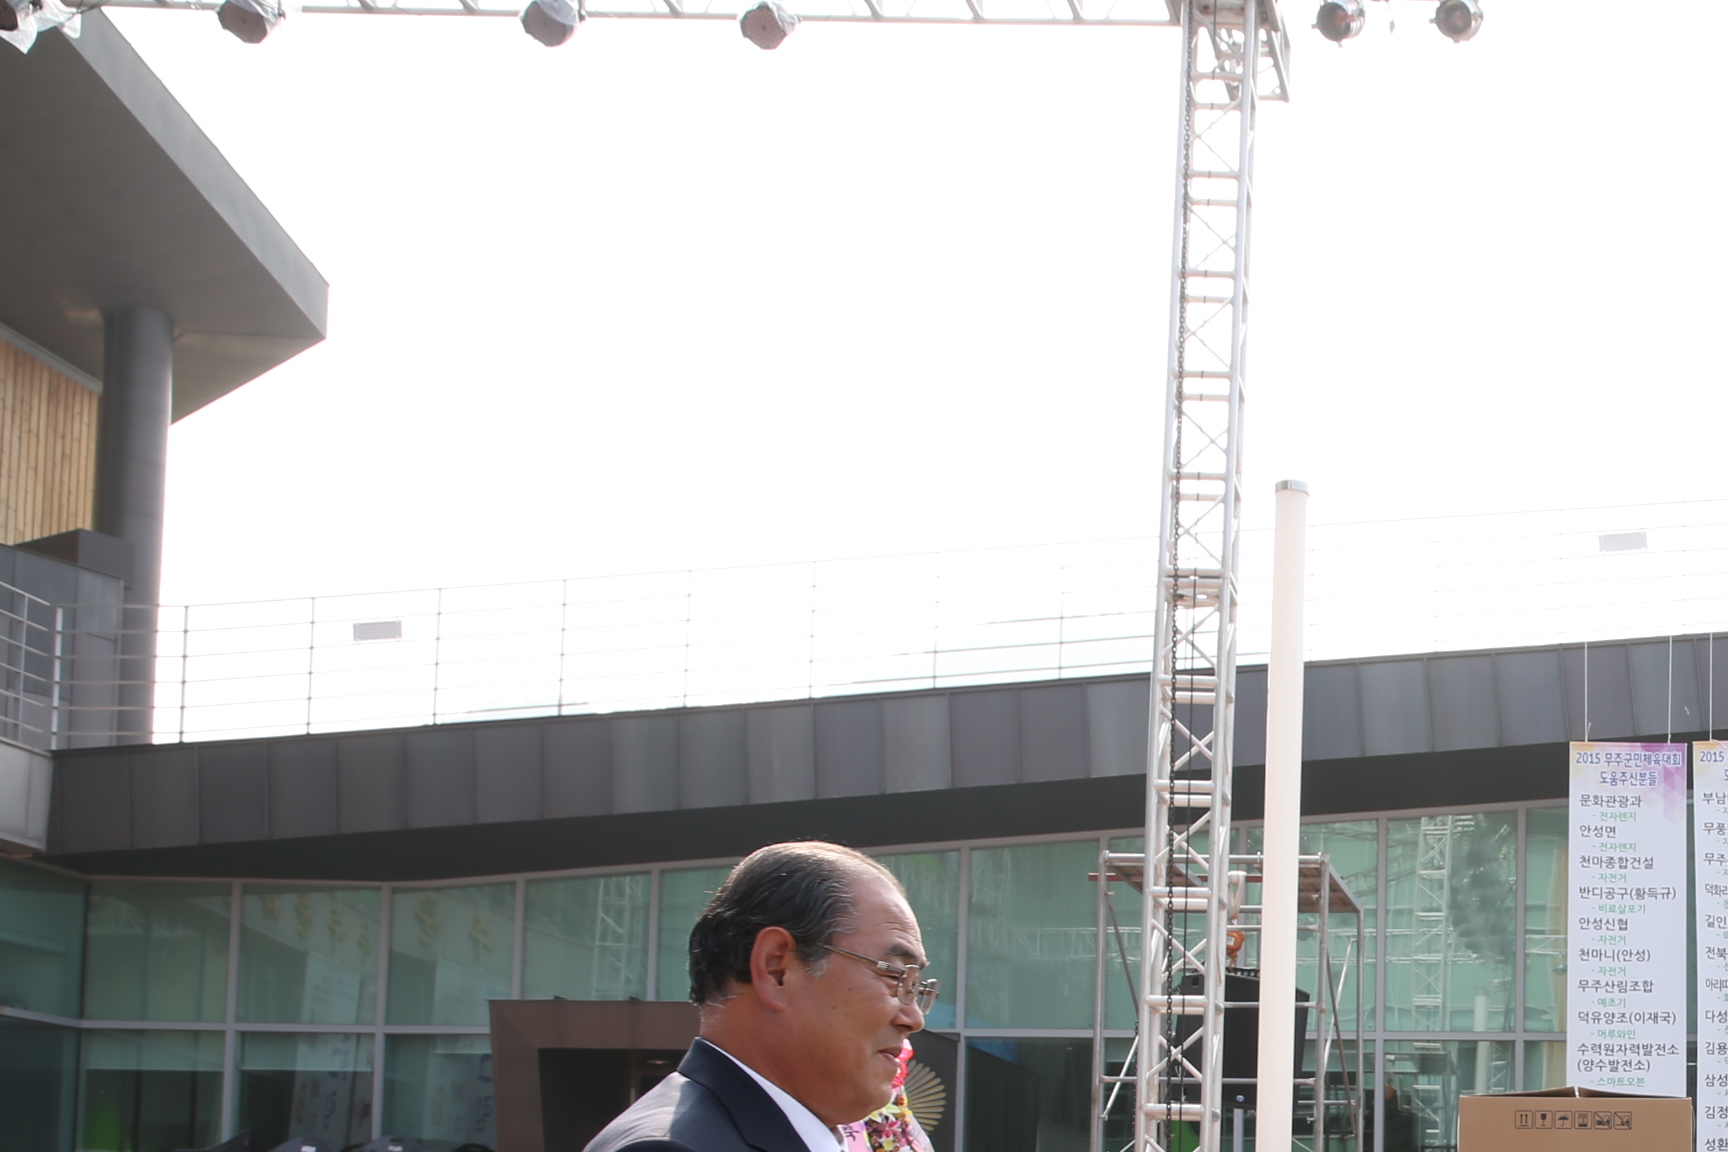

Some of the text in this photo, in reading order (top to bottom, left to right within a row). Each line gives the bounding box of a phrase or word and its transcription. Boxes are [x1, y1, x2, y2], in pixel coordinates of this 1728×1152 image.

[1576, 752, 1681, 767] 2015 무주군민체육대회
[1700, 751, 1724, 762] 2015
[1599, 771, 1657, 786] 도움주신분들
[1579, 794, 1642, 808] 문화관광과
[1599, 812, 1636, 821] 전자렌지
[1580, 825, 1616, 838] 안성면
[1599, 842, 1636, 852] 전자렌지
[1580, 856, 1654, 870] 천마종합건설
[1598, 873, 1627, 883] 자전거
[1579, 886, 1676, 900] 반디공구(황득규)
[1598, 904, 1646, 914] 비료살포기
[1579, 917, 1628, 931] 안성신협
[1598, 935, 1626, 945] 자전거
[1579, 948, 1651, 962] 천마니(안성)
[1598, 966, 1626, 976] 자전거
[1578, 979, 1654, 993] 무주산림조합
[1598, 998, 1626, 1008] 예초기
[1578, 1011, 1676, 1025] 덕유양조(이재국)
[1598, 1029, 1636, 1039] 머루와인
[1577, 1043, 1679, 1056] 수력원자력발전소
[1578, 1059, 1650, 1072] (양수발전소)
[1596, 1077, 1645, 1087] 스마트오븐
